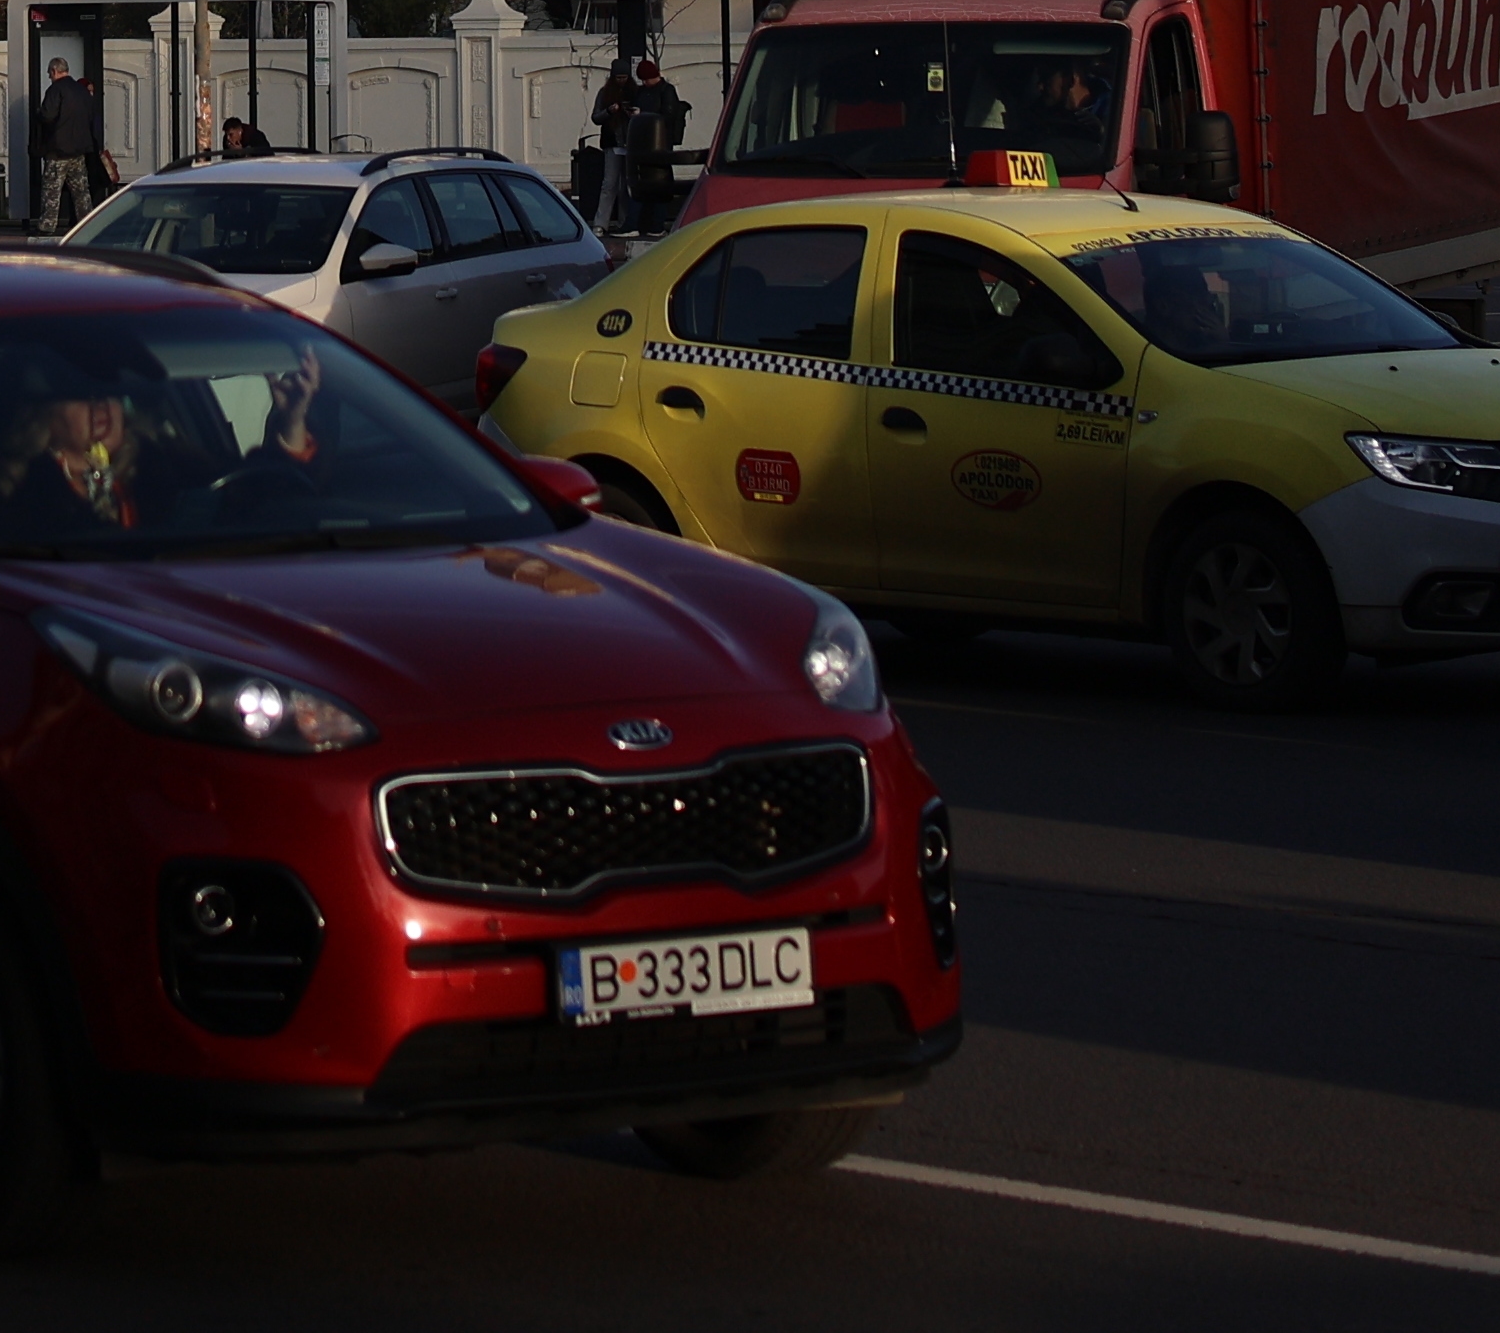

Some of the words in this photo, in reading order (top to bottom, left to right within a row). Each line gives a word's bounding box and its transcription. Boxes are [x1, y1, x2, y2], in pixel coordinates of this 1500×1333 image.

[1009, 154, 1046, 181] TAXI
[1126, 227, 1239, 243] APOLODOR
[1056, 423, 1081, 441] 2,69
[959, 472, 1034, 491] APOLODOR
[970, 488, 999, 501] TAXI
[590, 954, 619, 1003] B
